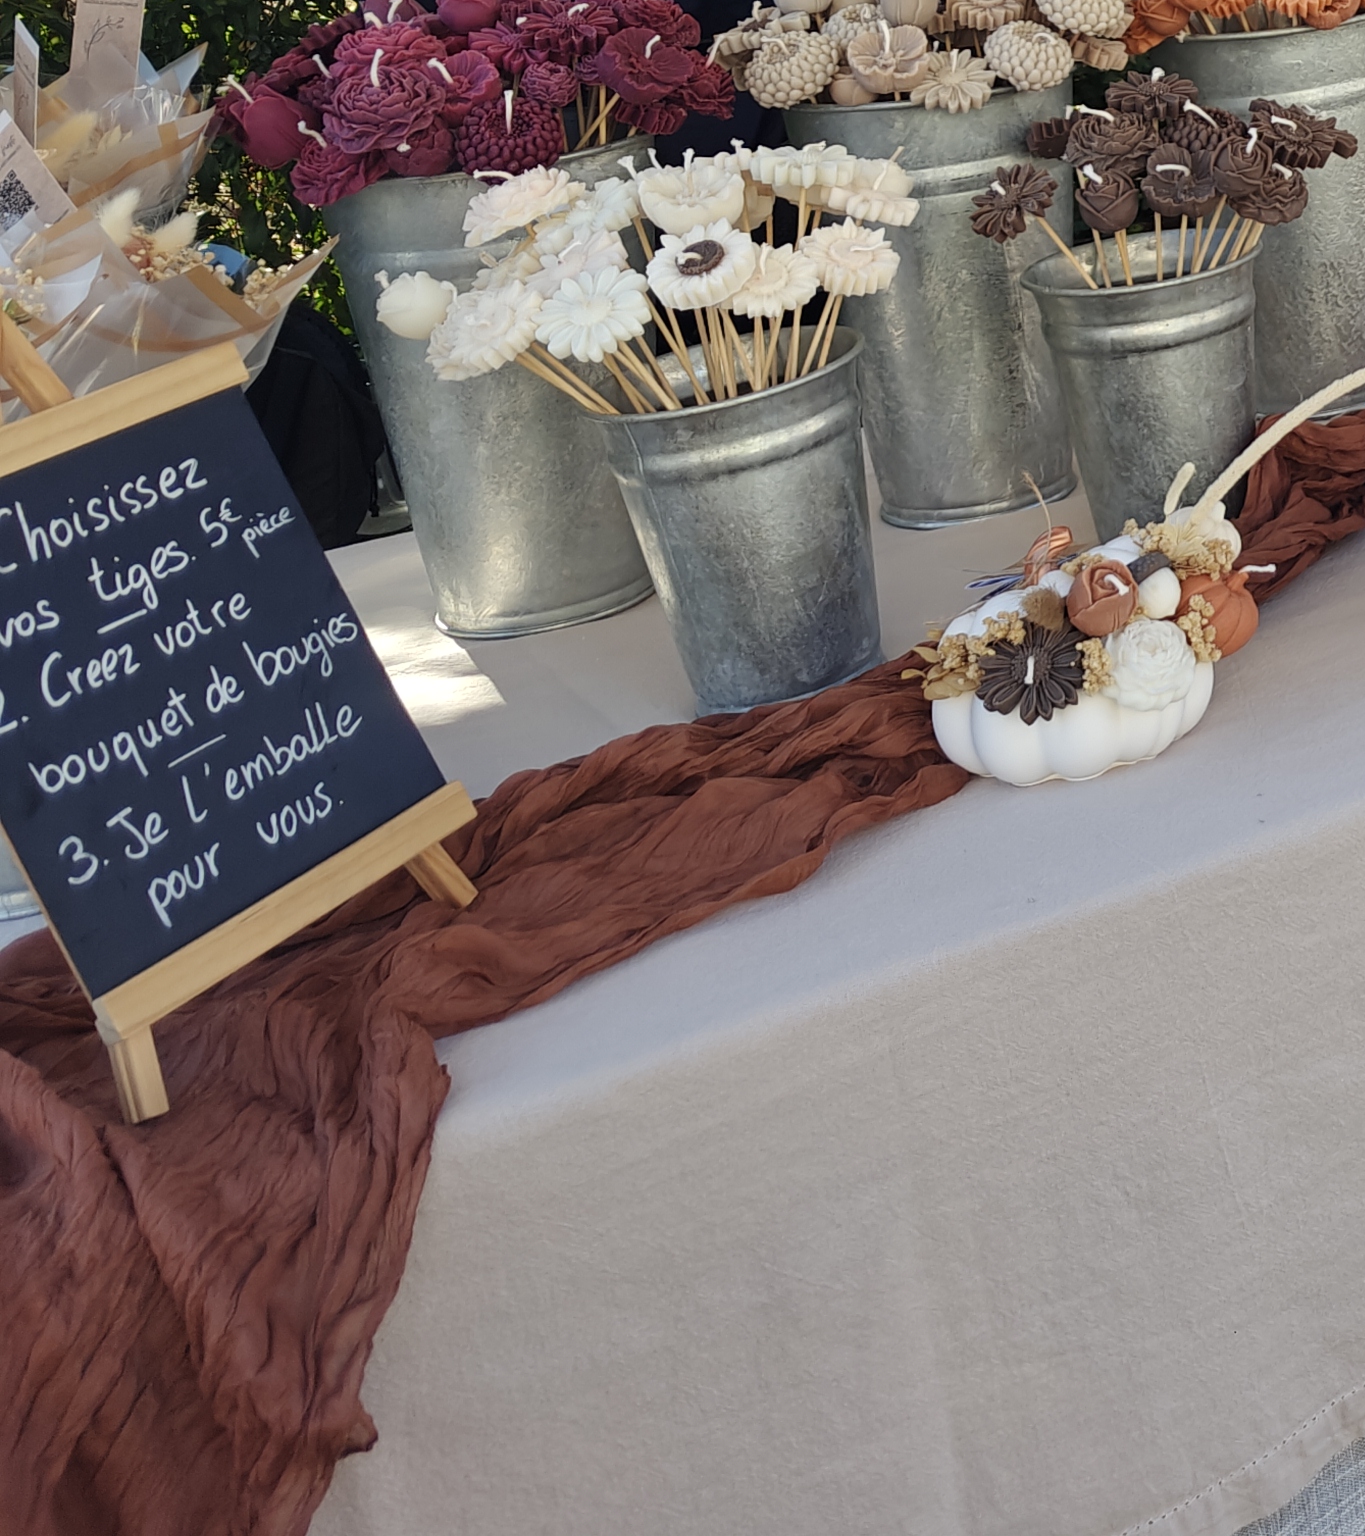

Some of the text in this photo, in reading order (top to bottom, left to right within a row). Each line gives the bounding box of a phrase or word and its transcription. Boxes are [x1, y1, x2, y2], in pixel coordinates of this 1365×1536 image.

[0, 496, 296, 648] vos tiges. 5€ pièce
[28, 612, 359, 794] bouquet de bougies
[41, 651, 141, 708] Creez
[153, 591, 252, 656] votre
[58, 835, 110, 885] 3.
[105, 806, 169, 860] Je
[147, 781, 345, 929] pour vous.
